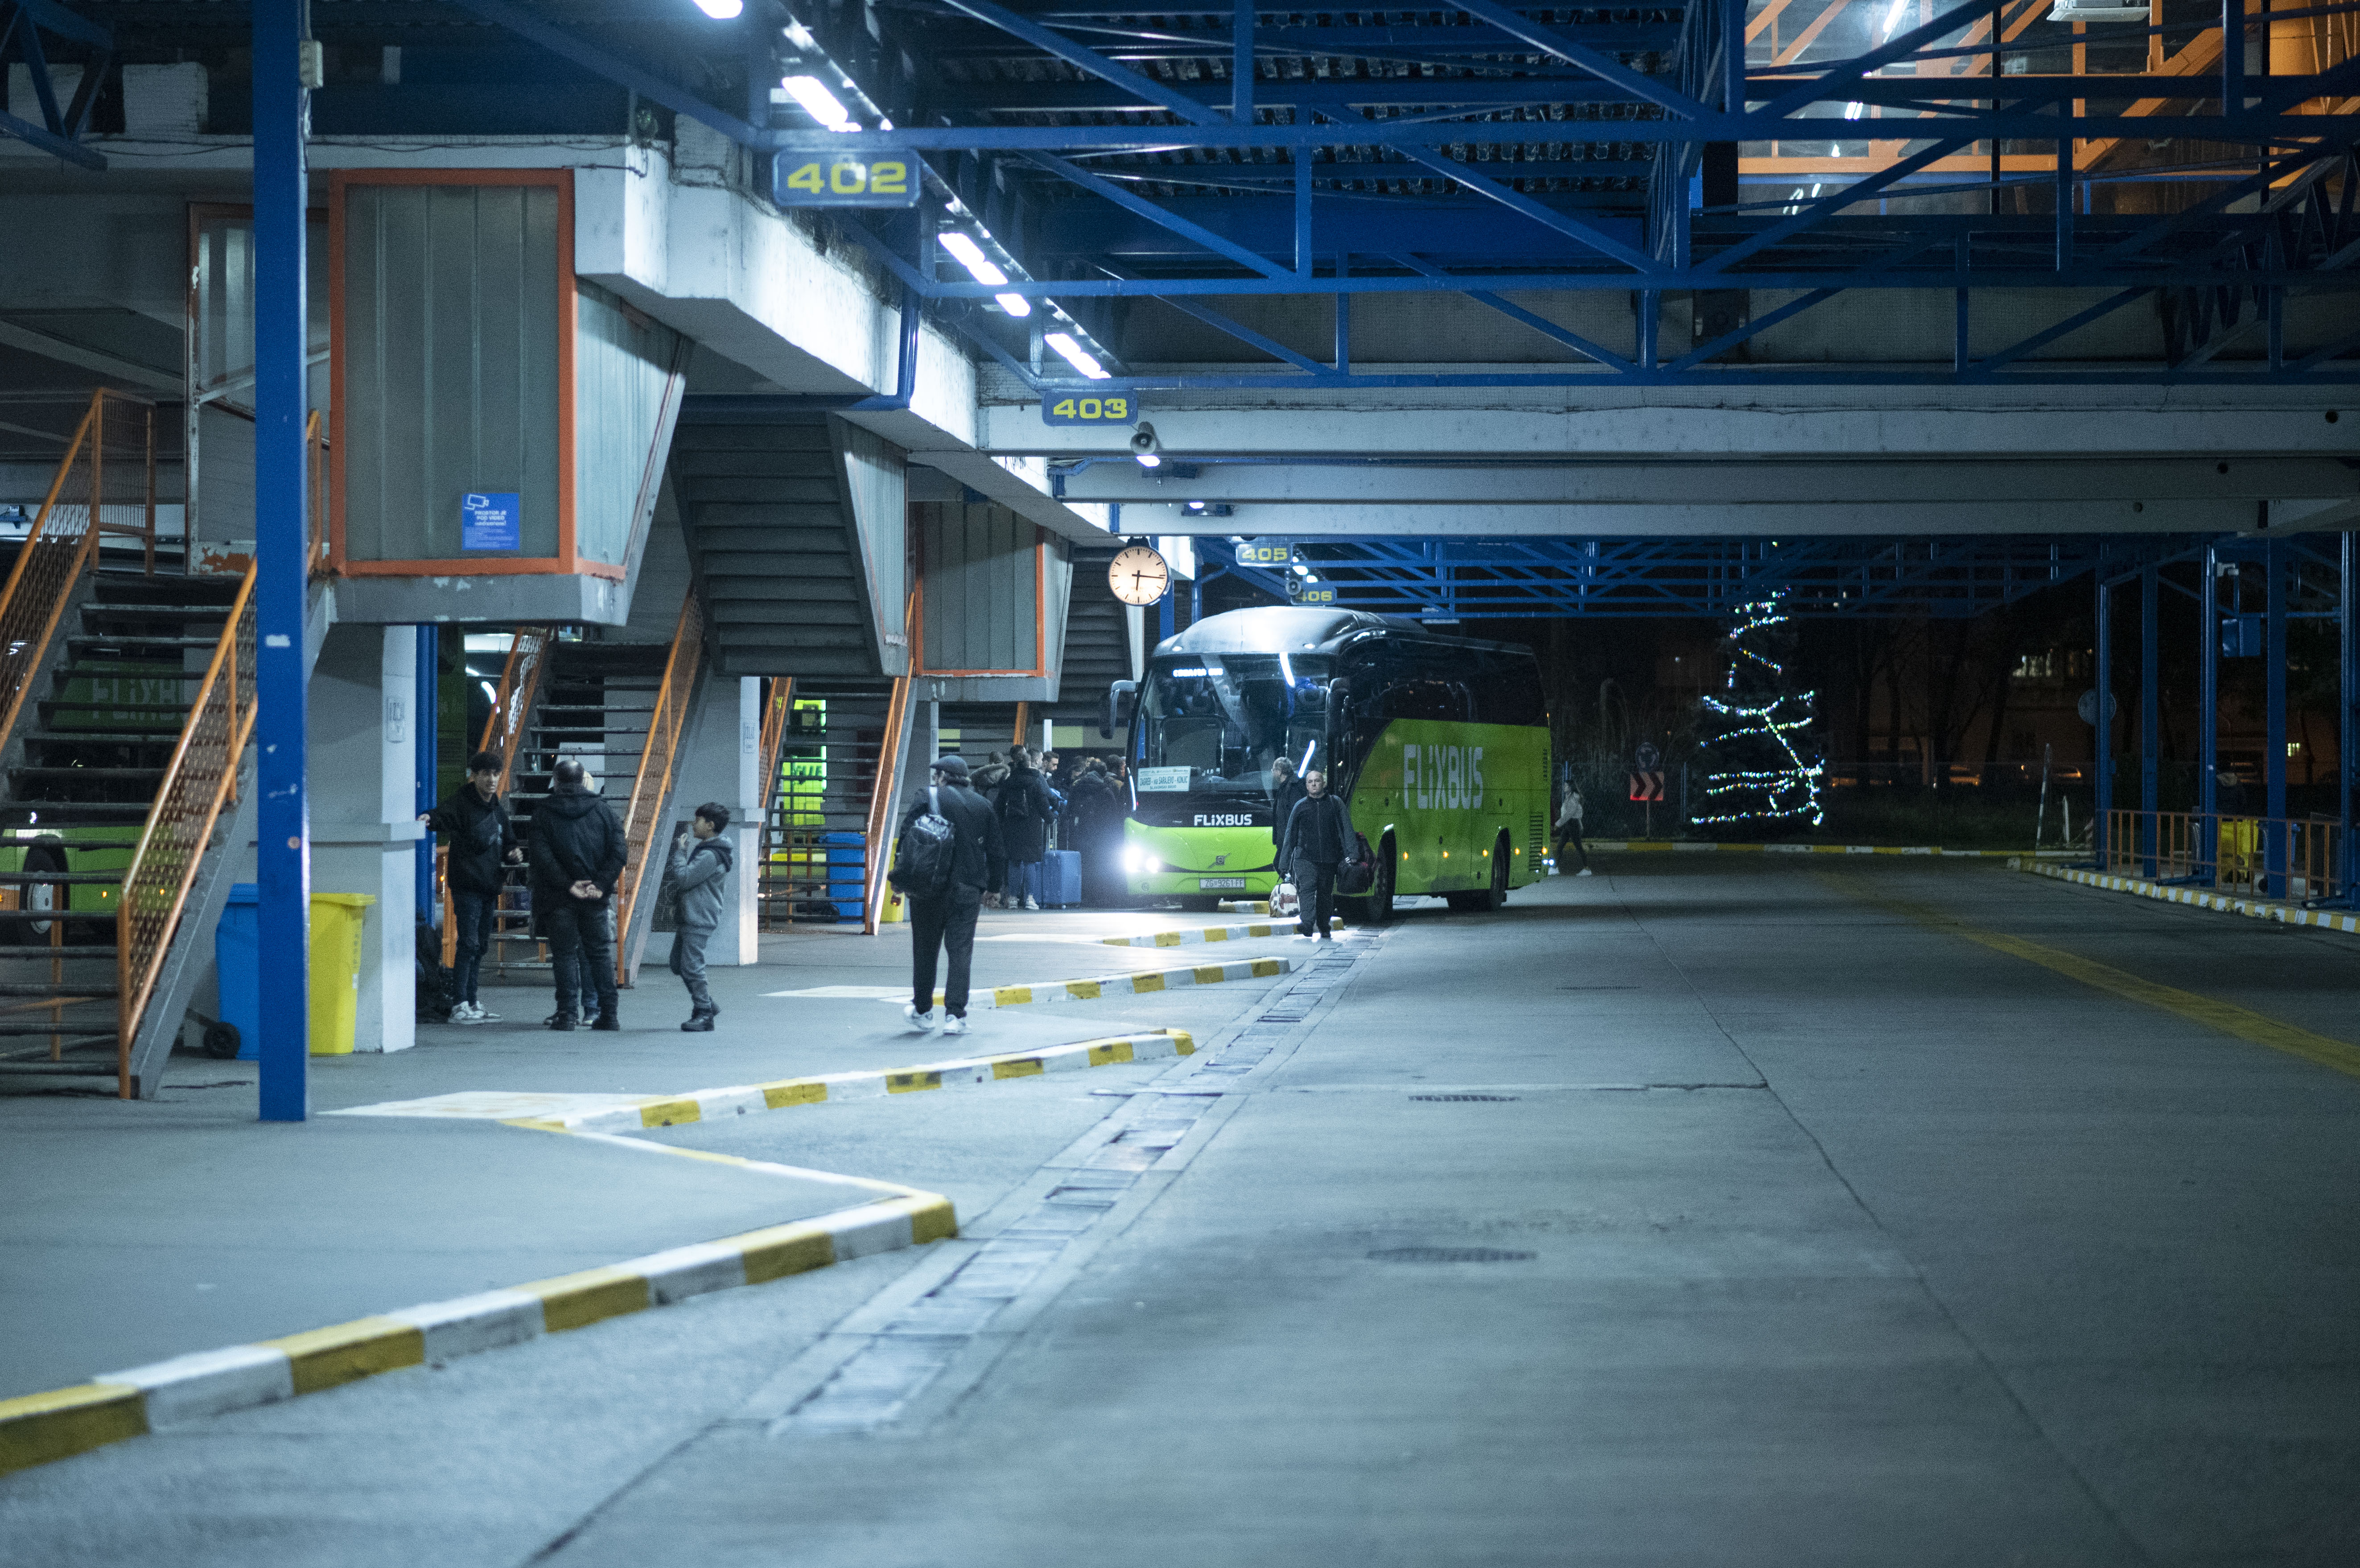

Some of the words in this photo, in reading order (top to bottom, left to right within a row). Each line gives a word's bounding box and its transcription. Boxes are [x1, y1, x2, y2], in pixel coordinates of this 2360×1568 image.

[787, 161, 907, 194] 402
[1053, 399, 1127, 419] 403
[1242, 548, 1288, 561] 405
